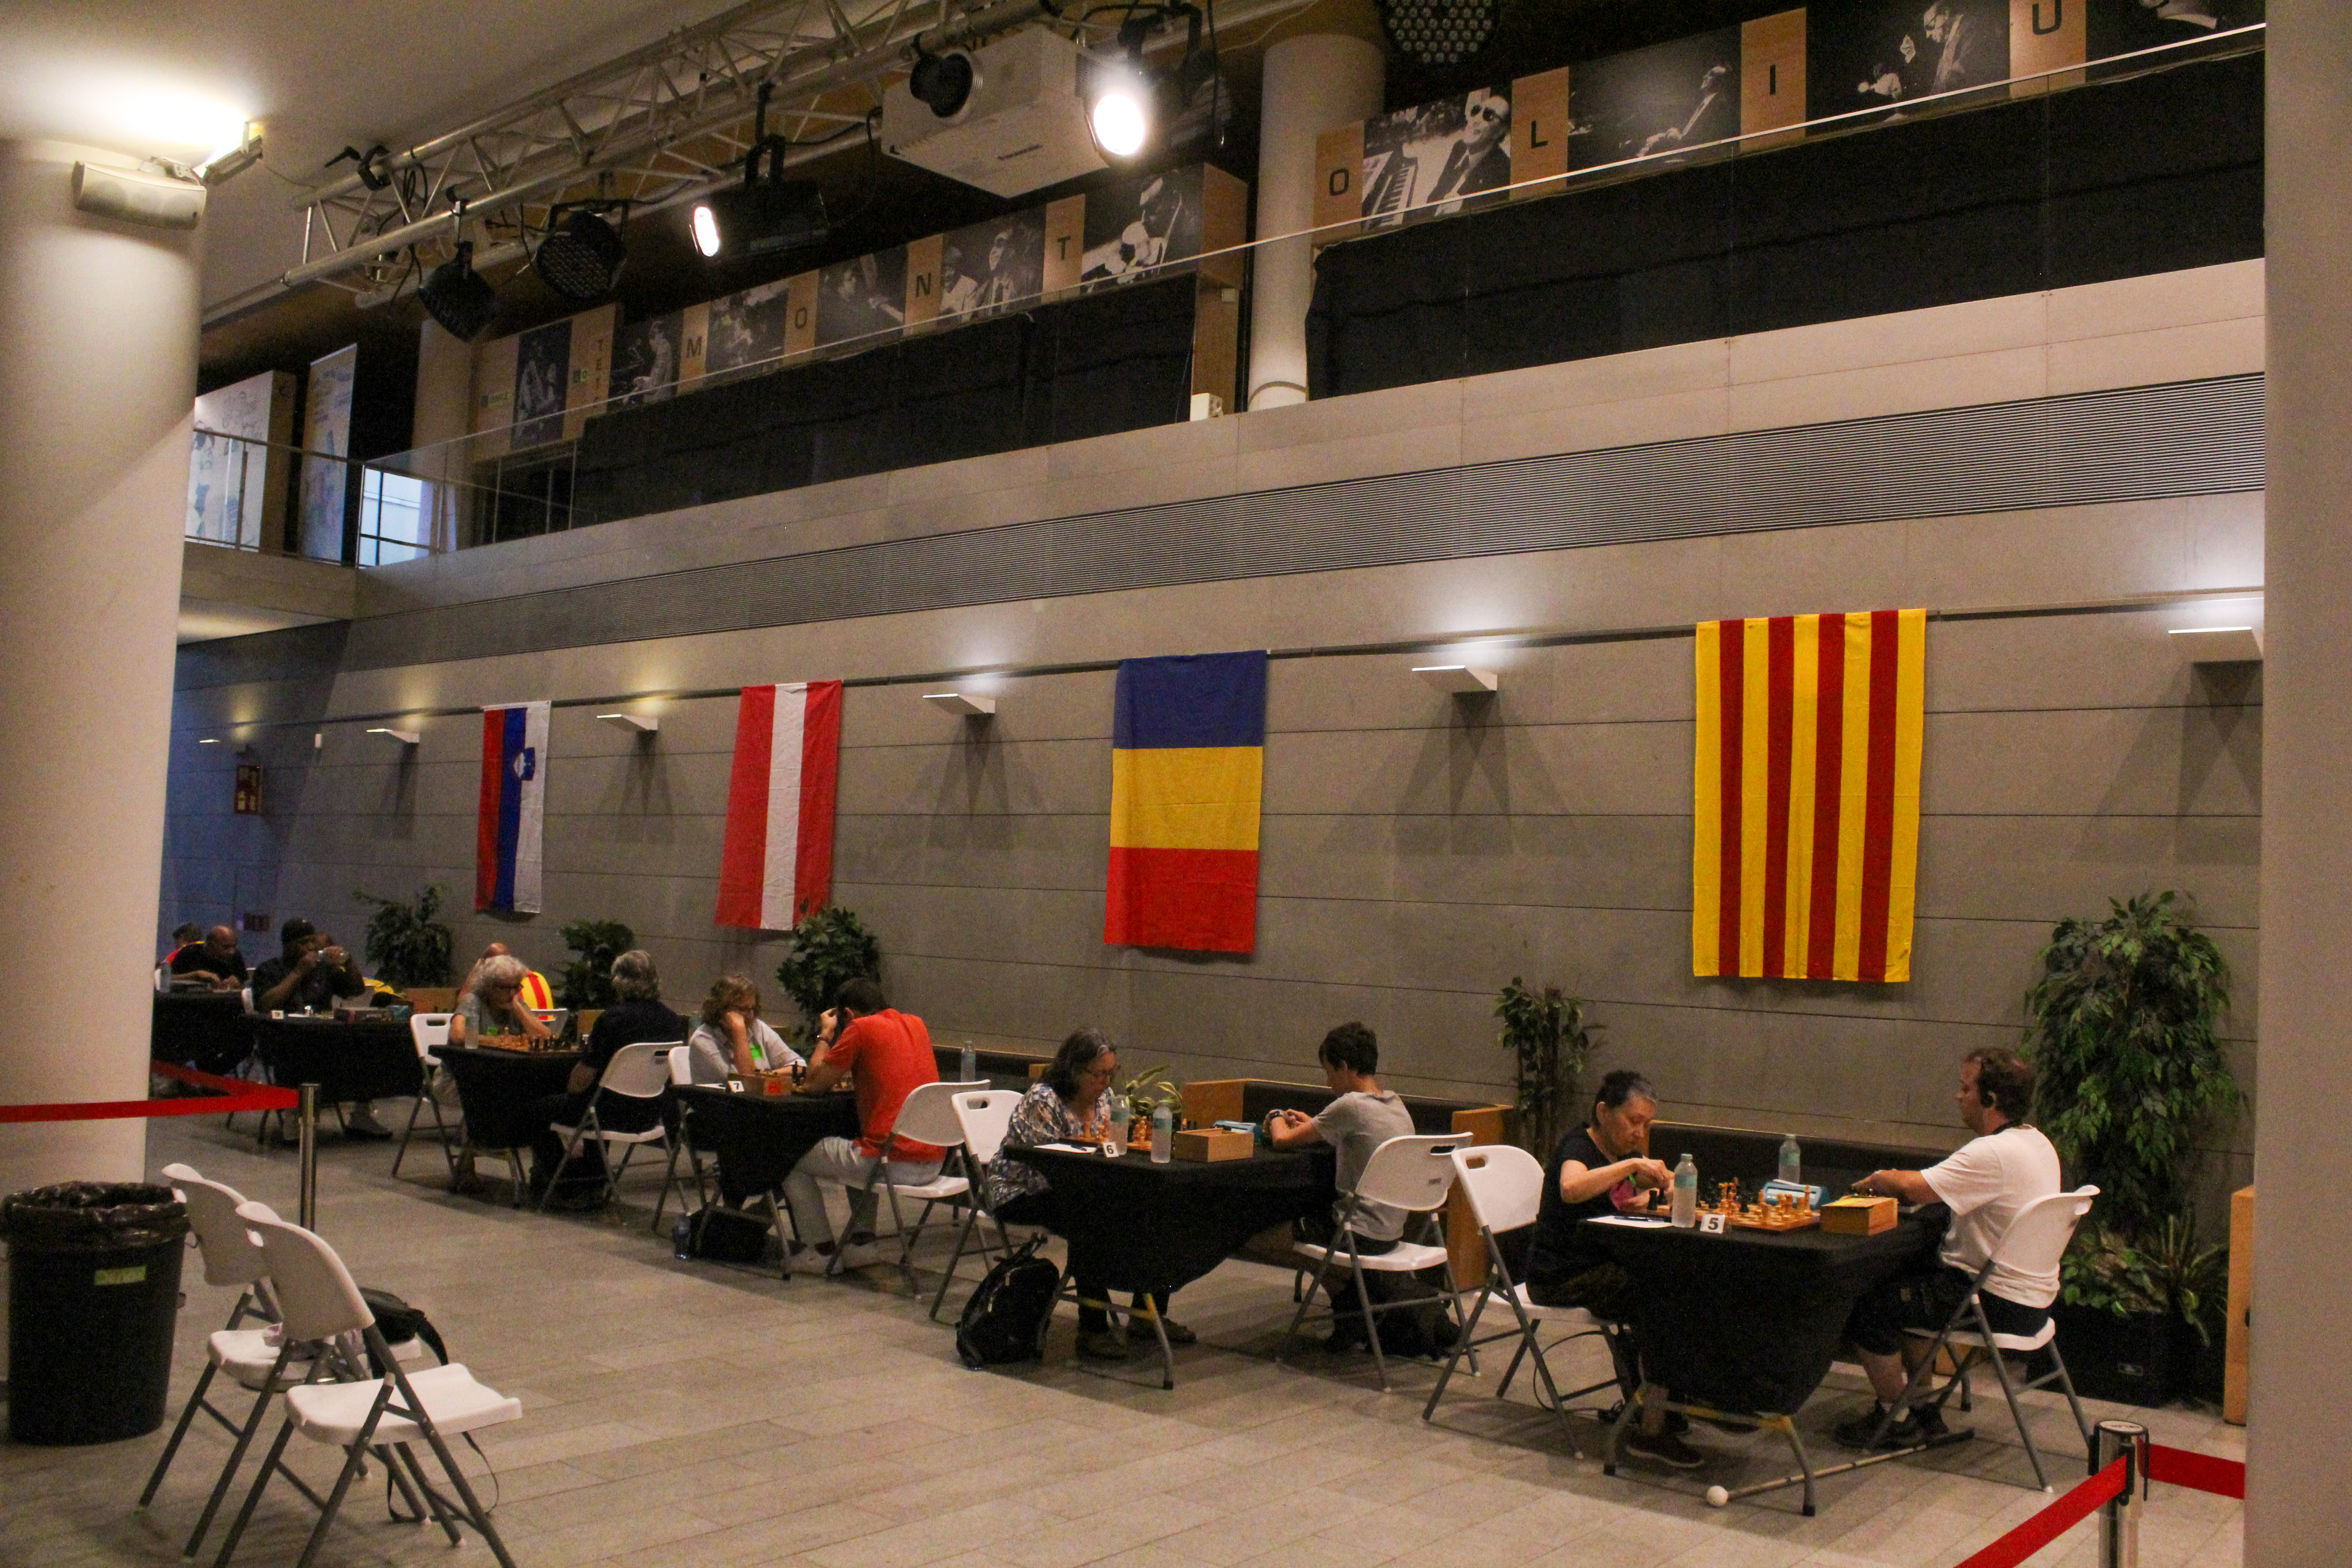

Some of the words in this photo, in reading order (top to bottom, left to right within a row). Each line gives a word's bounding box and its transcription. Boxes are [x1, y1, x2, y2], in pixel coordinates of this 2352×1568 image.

[686, 336, 703, 358] M
[795, 307, 808, 329] O
[915, 273, 931, 297] N
[1057, 235, 1071, 261] T
[1329, 168, 1349, 196] O
[1531, 121, 1548, 148] L
[1769, 64, 1776, 95] I
[2032, 0, 2062, 34] U
[1106, 1145, 1114, 1154] 6
[1708, 1217, 1719, 1230] 5
